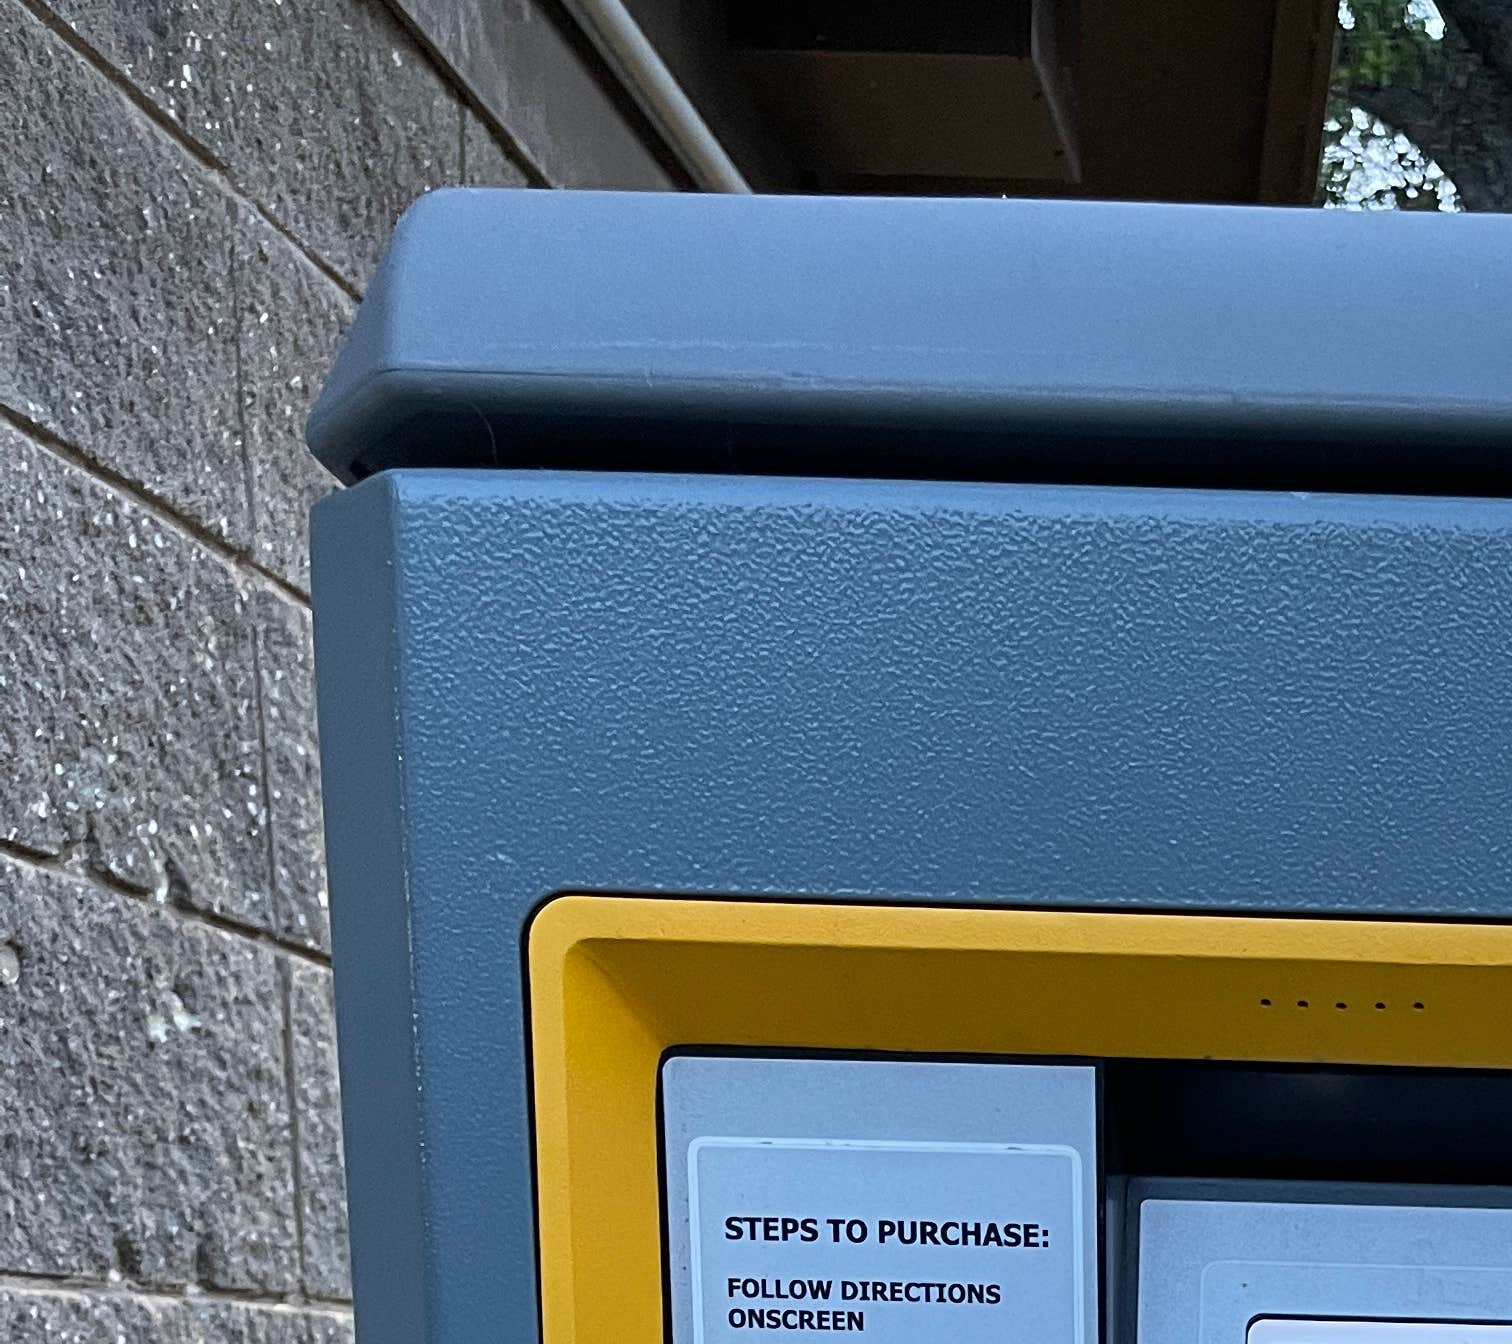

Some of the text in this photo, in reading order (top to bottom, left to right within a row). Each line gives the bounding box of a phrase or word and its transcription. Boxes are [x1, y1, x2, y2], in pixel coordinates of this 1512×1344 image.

[725, 1216, 1049, 1248] STEPS TO PURCHASE:
[727, 1277, 1001, 1305] FOLLOW DIRECTIONS
[728, 1308, 864, 1332] ONSCREEN
